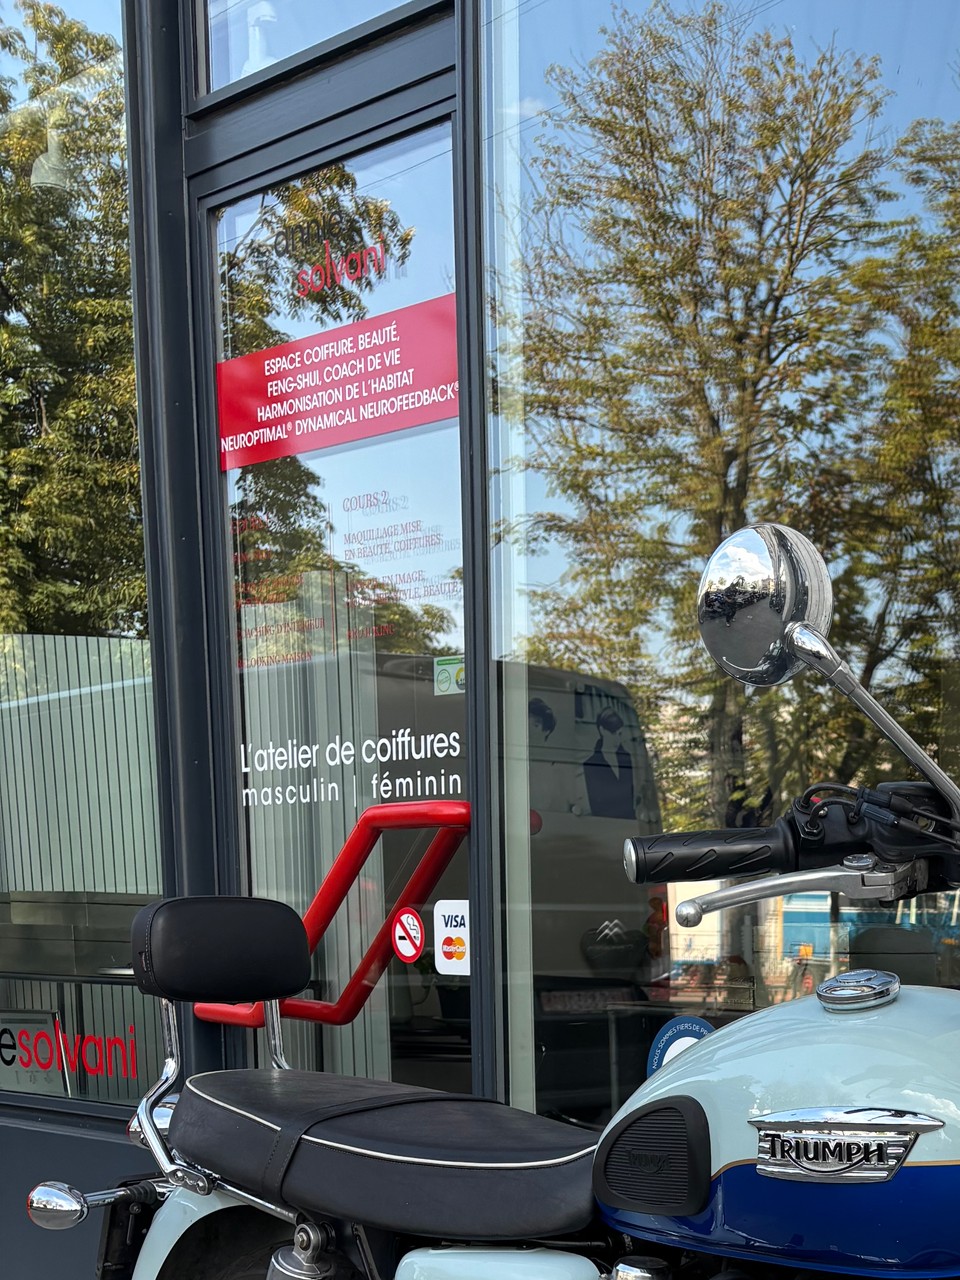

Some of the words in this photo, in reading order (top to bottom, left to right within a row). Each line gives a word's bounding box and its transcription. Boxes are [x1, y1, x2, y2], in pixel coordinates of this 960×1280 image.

[274, 207, 342, 258] annie
[297, 232, 385, 297] solvani
[264, 352, 302, 376] ESPACE
[303, 340, 357, 365] COIFFURE,
[358, 320, 400, 348] BEAUTÉ,
[257, 386, 343, 422] HARMONISATION
[345, 385, 360, 401] DE
[362, 368, 414, 397] L'HABITAT
[267, 370, 322, 397] FENG-SHUI,
[323, 360, 364, 383] COACH
[368, 356, 382, 371] DE
[383, 348, 401, 367] VIE
[295, 408, 357, 436] DYNAMICAL
[343, 491, 379, 512] COURS
[381, 490, 388, 505] 2
[344, 523, 399, 545] MAQUILLAGE
[400, 519, 422, 535] MISE
[240, 738, 319, 773] L'atelier
[325, 735, 355, 766] de
[361, 728, 461, 764] coiffures
[242, 778, 339, 807] masculin
[371, 769, 462, 799] féminin
[441, 914, 466, 928] VISA
[652, 1049, 661, 1069] NOUS
[676, 1023, 692, 1031] FIERS
[692, 1023, 700, 1032] DE
[765, 1133, 885, 1174] TRIUMPH
